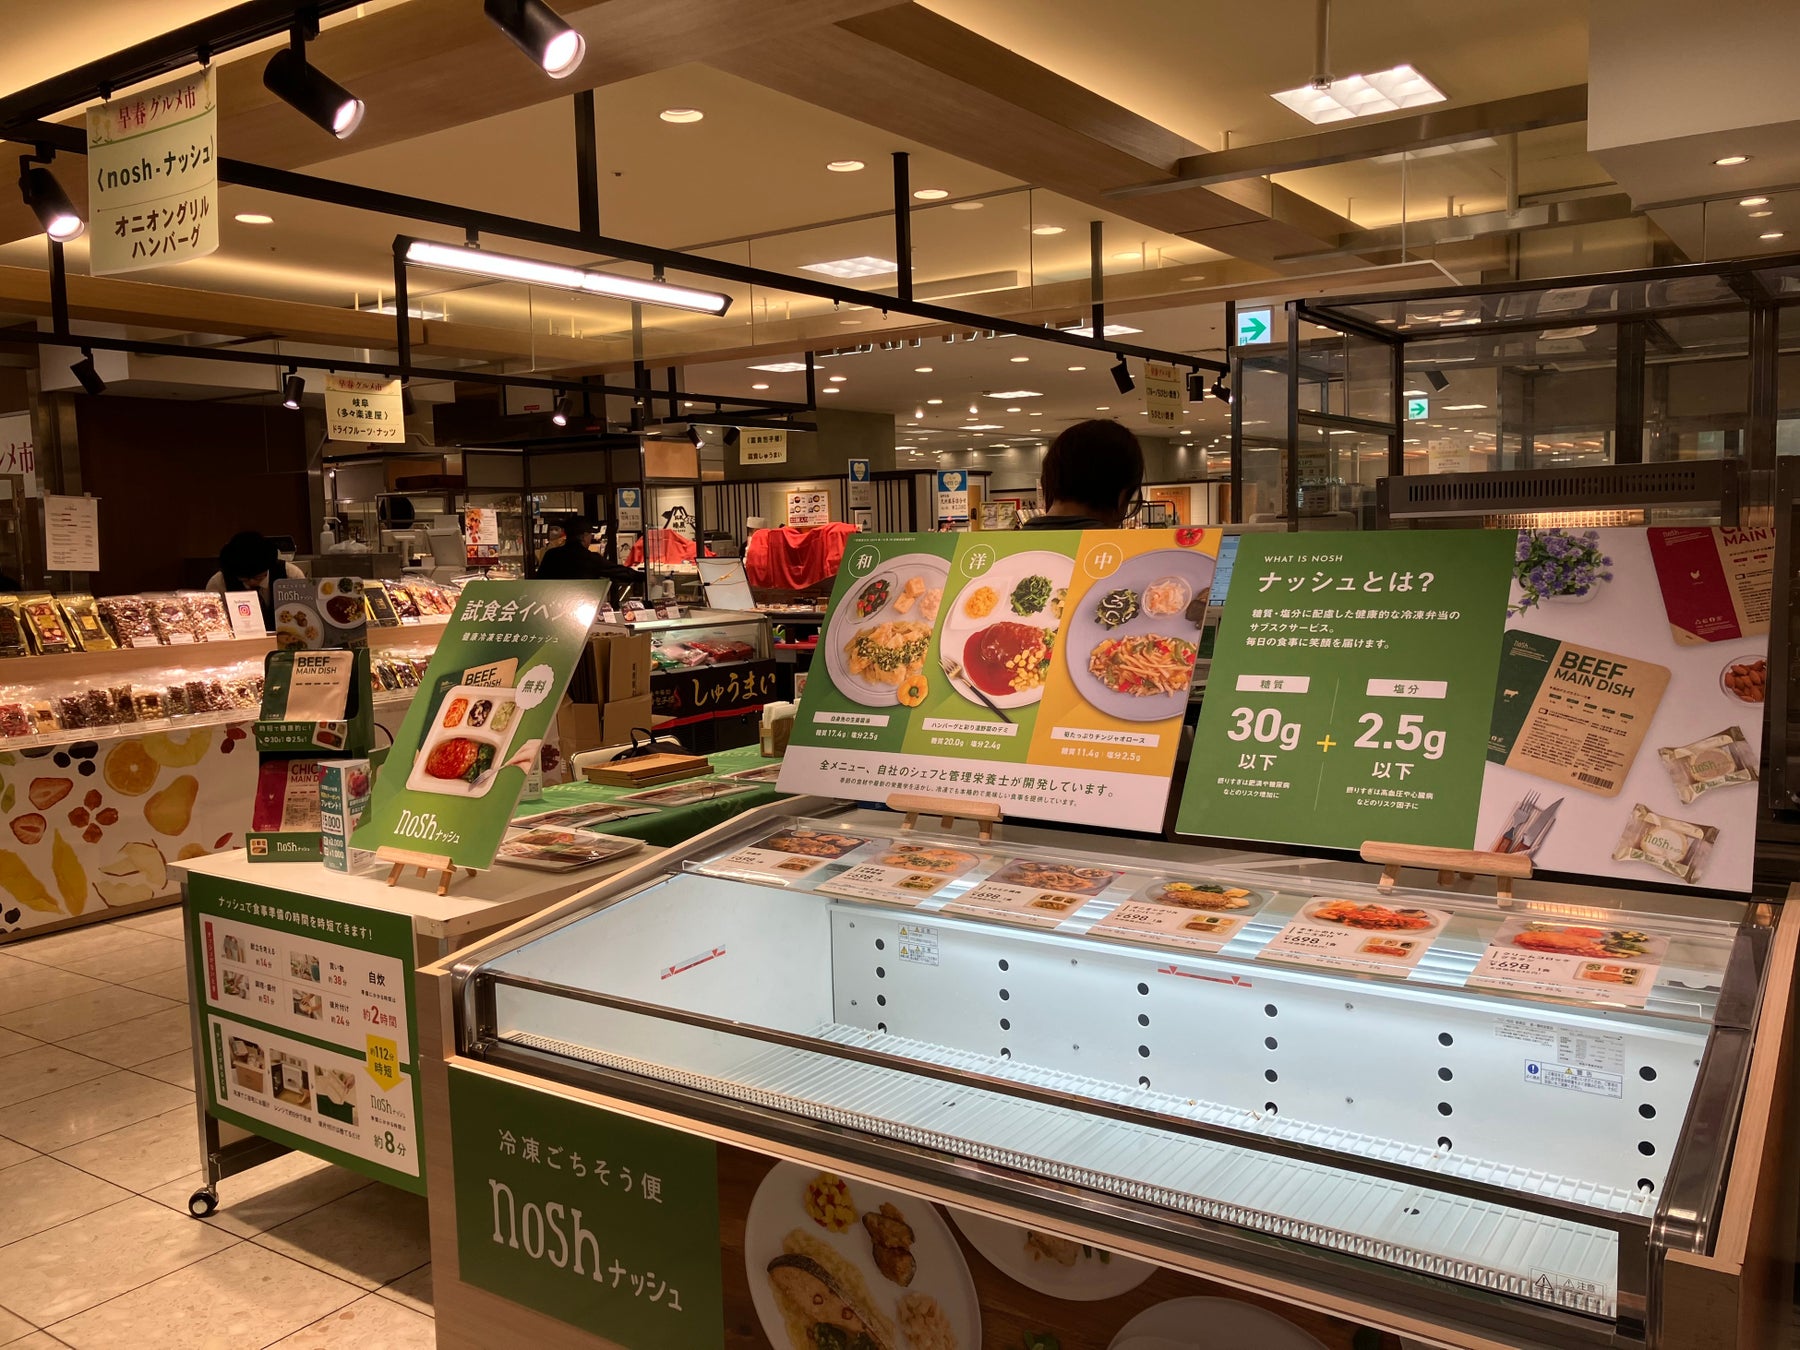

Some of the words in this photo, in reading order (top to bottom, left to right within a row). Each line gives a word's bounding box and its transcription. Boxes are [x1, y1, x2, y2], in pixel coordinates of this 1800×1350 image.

[118, 85, 196, 129] 早春グルメ市
[115, 195, 209, 237] オニオングリル
[132, 224, 200, 258] ハンバーグ
[1722, 529, 1767, 547] MAIN
[856, 553, 872, 569] 和
[969, 552, 987, 569] 洋
[1094, 551, 1112, 571] 中
[1264, 555, 1294, 563] WHAT
[1298, 555, 1308, 563] IS
[1312, 554, 1343, 563] NOSH
[1258, 570, 1435, 593] ナッシュとは?
[277, 590, 301, 600] nosh
[460, 600, 566, 622] 試食会イベン
[1252, 608, 1460, 621] 糖質・塩分に配慮した健康的な冷凍弁当の
[1250, 622, 1335, 633] サブスクサービス。
[1245, 636, 1390, 650] 毎日の食事に笑顔を届けます。
[297, 656, 330, 667] BEEF
[1559, 650, 1628, 680] BEEF
[296, 667, 316, 675] MAIN
[317, 667, 337, 675] DISH
[465, 667, 498, 686] BEEF
[522, 680, 546, 693] 無料
[692, 670, 776, 707] しゅうまい
[1260, 679, 1284, 690] 糖質
[1394, 683, 1419, 695] 塩分
[1554, 668, 1594, 688] MAIN
[1596, 676, 1635, 698] DISH
[1227, 707, 1301, 751] 30g
[1354, 712, 1447, 760] 2.5g
[1238, 753, 1277, 771] 以下
[1371, 761, 1414, 781] 以下
[291, 775, 312, 783] MAIN
[819, 759, 1114, 798] 全メニュー、自社のシェフと管理栄養士が開発しています。
[394, 809, 437, 841] nosh
[435, 830, 460, 844] ナッシュ
[277, 842, 298, 852] nosh
[971, 892, 1001, 900] ¥698
[1116, 913, 1149, 921] ¥698
[1283, 934, 1320, 945] ¥698
[1489, 960, 1531, 970] ¥698
[368, 971, 386, 987] 自炊
[363, 1005, 398, 1029] 約2時間
[370, 1046, 394, 1061] 約112分
[374, 1062, 393, 1078] 時短
[370, 1095, 392, 1115] nosh
[374, 1131, 407, 1157] 約8分
[498, 1129, 663, 1204] 冷凍ごちそう便
[488, 1178, 603, 1283] nosh
[608, 1258, 683, 1311] ナッシュ
